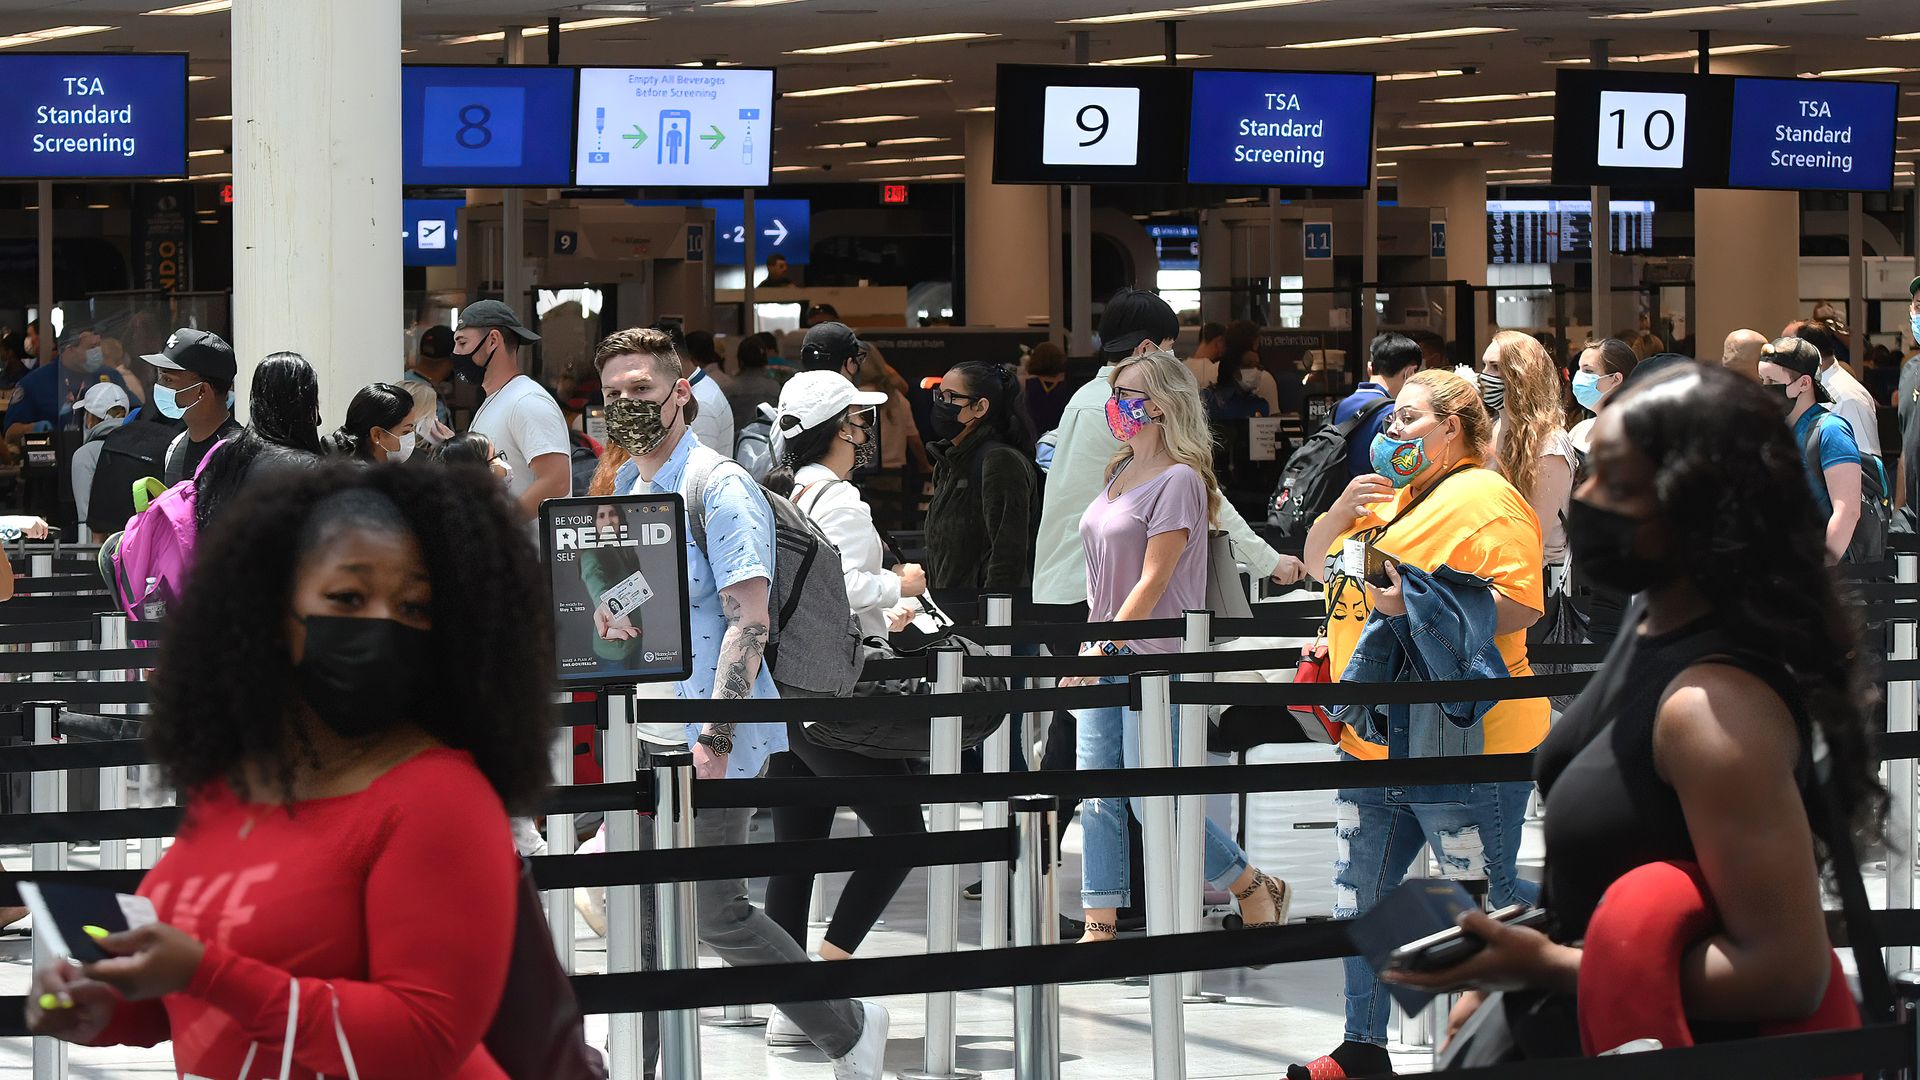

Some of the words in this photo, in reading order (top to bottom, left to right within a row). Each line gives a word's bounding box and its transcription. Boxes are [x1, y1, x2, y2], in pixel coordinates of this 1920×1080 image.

[62, 76, 105, 96] TSA
[628, 74, 659, 86] Empty
[661, 75, 675, 84] All
[676, 75, 725, 86] Beverages
[635, 87, 668, 97] Before
[670, 88, 717, 99] Screening
[1264, 93, 1301, 111] TSA
[36, 103, 132, 124] Standard
[1798, 100, 1832, 118] TSA
[455, 103, 492, 149] 8
[1074, 104, 1109, 147] 9
[1239, 118, 1323, 138] Standard
[1609, 109, 1675, 151] 10
[1775, 124, 1851, 144] Standard
[33, 132, 135, 157] Screening
[1234, 144, 1325, 168] Screening
[1770, 149, 1853, 173] Screening
[560, 234, 571, 249] 9
[1307, 232, 1330, 250] 11
[1432, 231, 1445, 249] 12
[555, 517, 566, 526] BE
[567, 515, 593, 525] YOUR
[555, 525, 639, 550] REAL
[641, 523, 672, 546] ID
[556, 552, 576, 562] SELF
